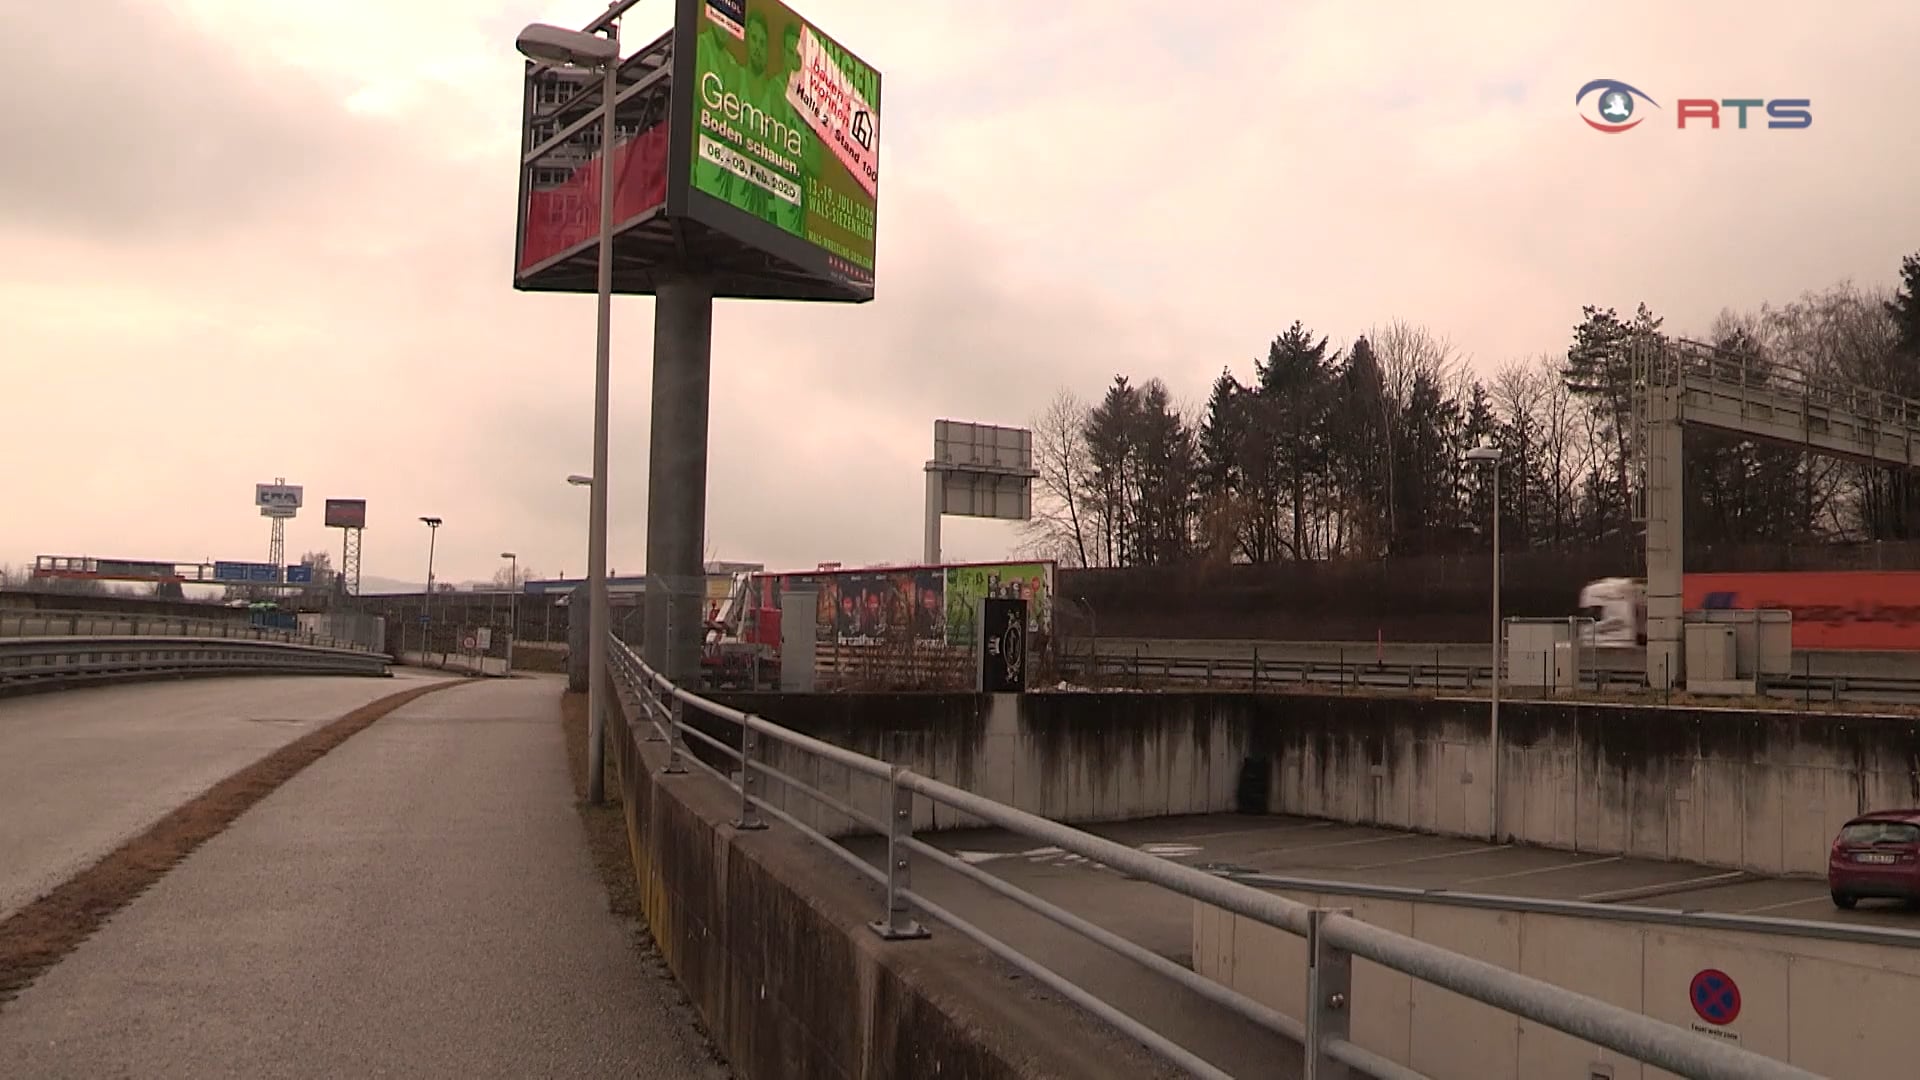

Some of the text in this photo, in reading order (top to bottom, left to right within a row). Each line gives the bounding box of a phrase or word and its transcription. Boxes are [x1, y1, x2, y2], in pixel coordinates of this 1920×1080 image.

[813, 56, 845, 104] bauen
[701, 109, 800, 178] Boden schauen.
[702, 72, 801, 157] Gemma
[796, 83, 877, 182] Halle 2 Stand 100
[772, 177, 796, 199] 2020
[838, 194, 853, 215] JULI
[856, 203, 874, 226] 2020
